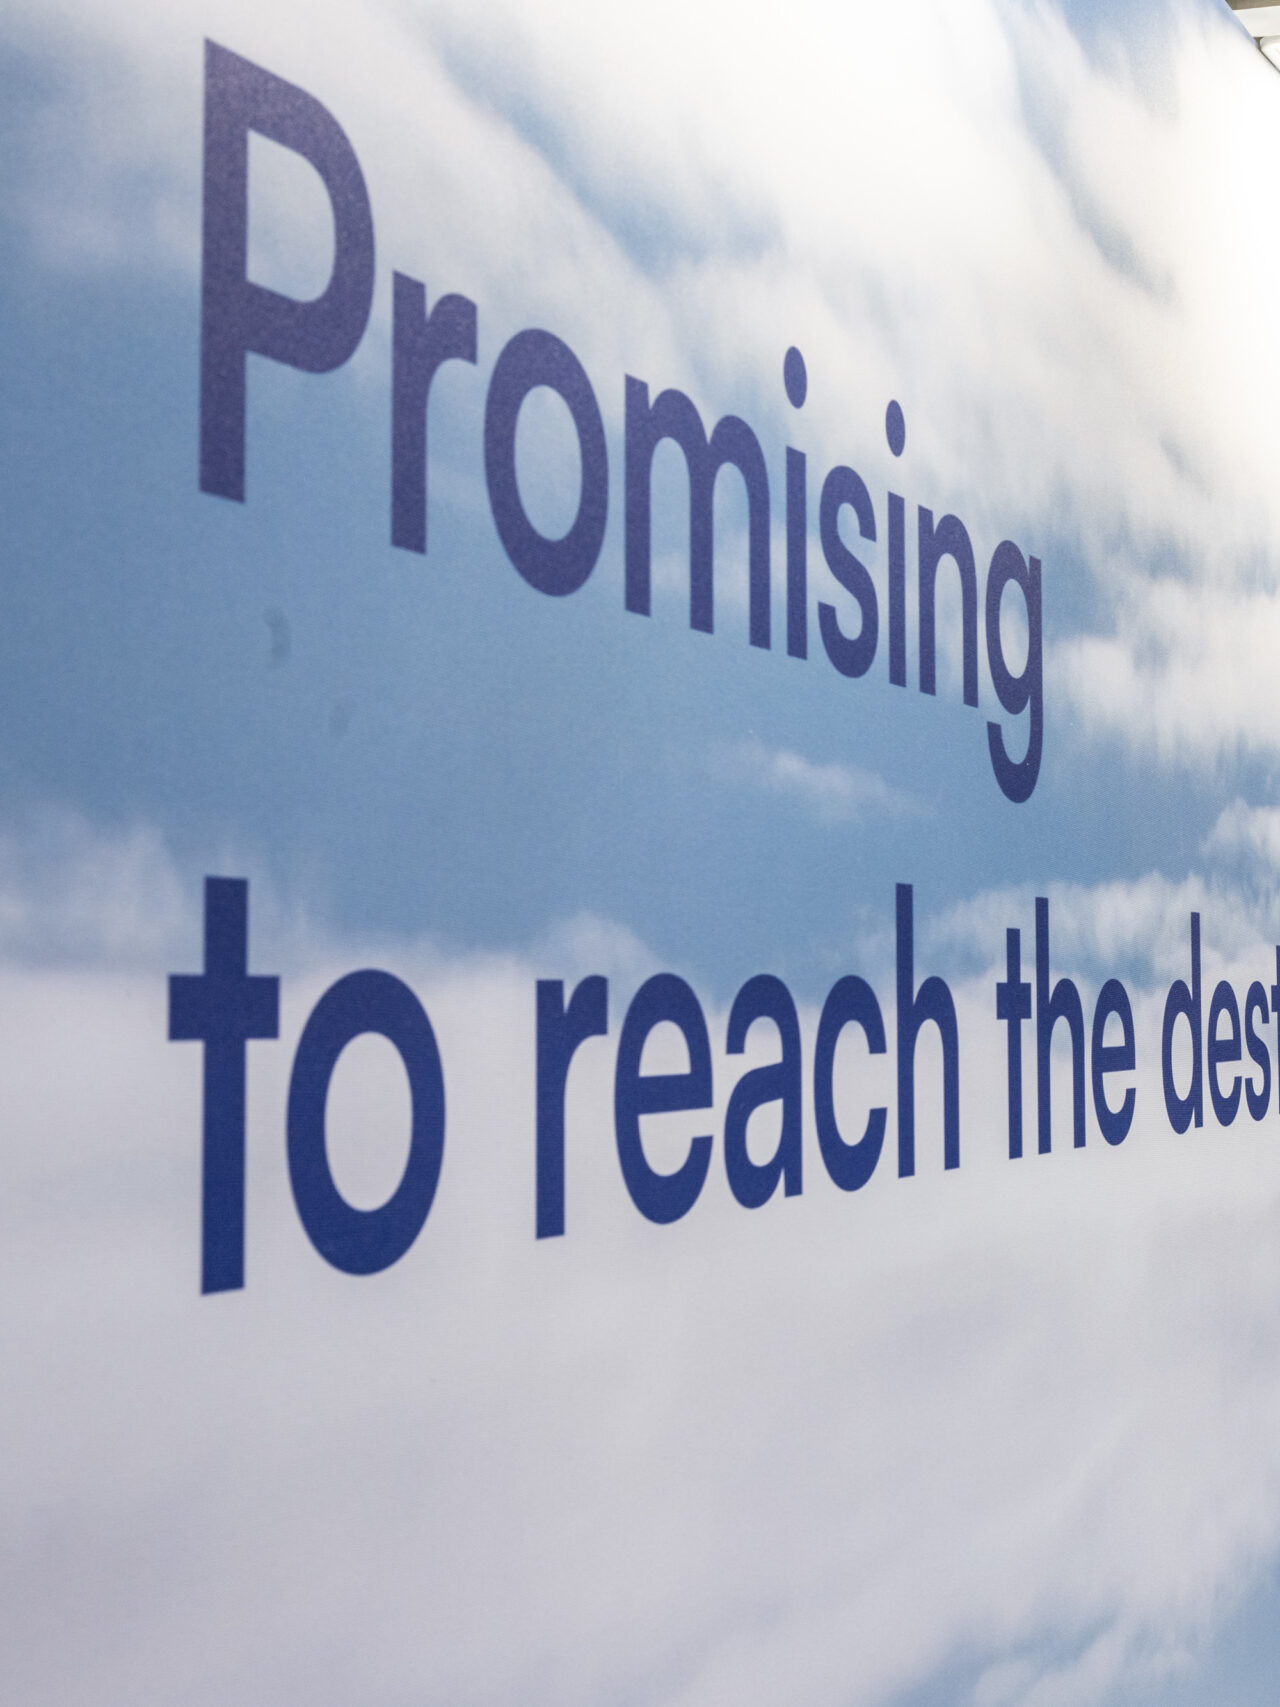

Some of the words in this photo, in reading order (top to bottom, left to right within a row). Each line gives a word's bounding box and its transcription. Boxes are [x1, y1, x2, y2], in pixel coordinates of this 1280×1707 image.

[198, 37, 1044, 804] Promising
[168, 876, 446, 1295] to
[535, 883, 960, 1240] reach
[997, 896, 1136, 1160] the
